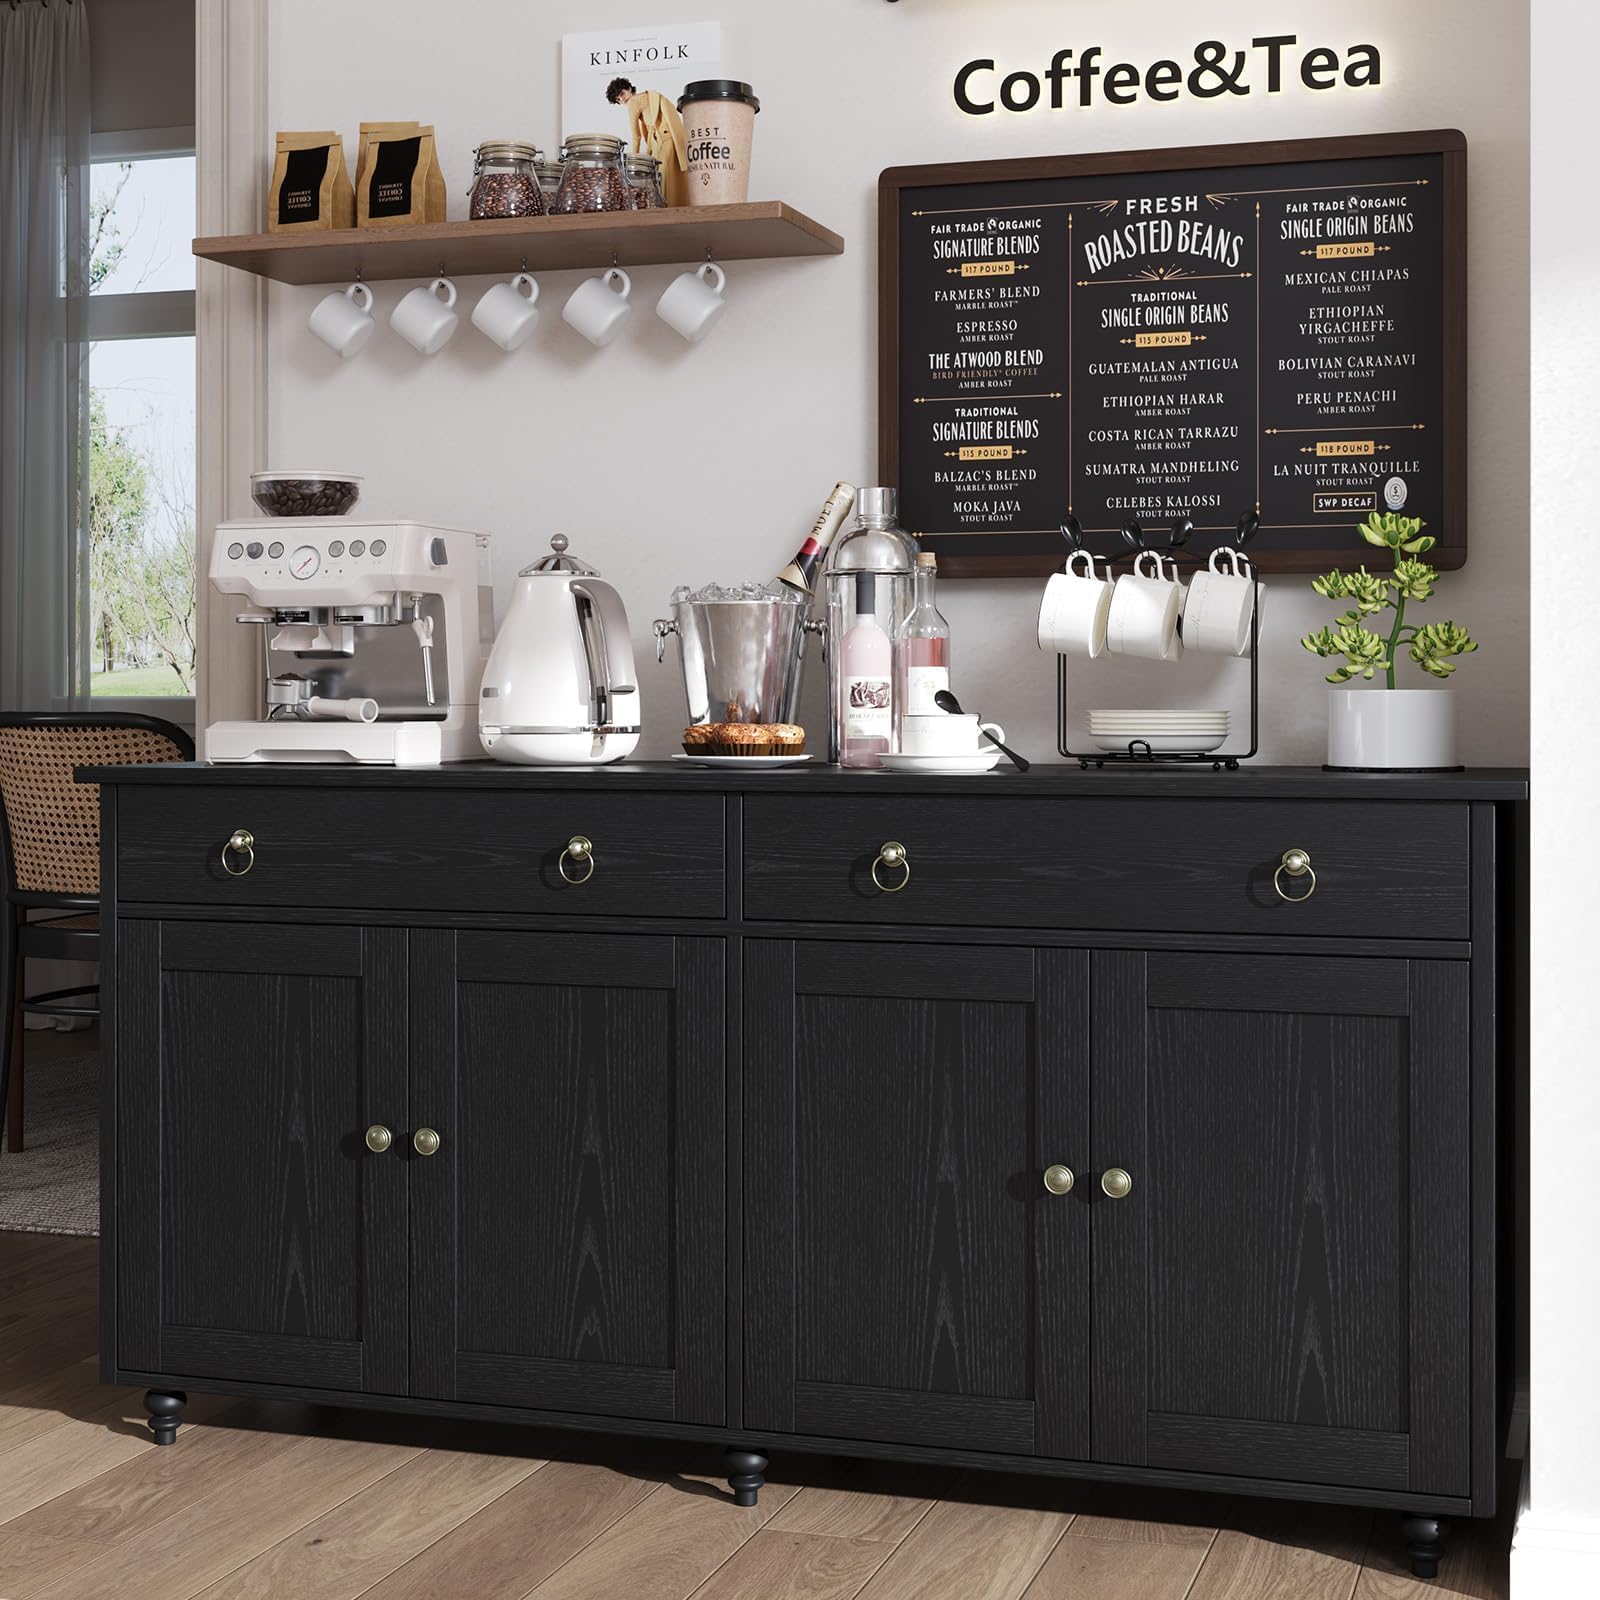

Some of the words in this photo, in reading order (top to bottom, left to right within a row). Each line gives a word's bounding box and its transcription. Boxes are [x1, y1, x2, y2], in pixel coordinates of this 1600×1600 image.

[590, 45, 688, 66] KINFOLK
[954, 34, 1382, 115] Coffee&Tea
[690, 128, 719, 138] BEST
[687, 142, 731, 162] Coffee
[704, 162, 735, 170] NATURAL
[1126, 196, 1198, 215] FRESH
[1286, 203, 1308, 213] FAIR
[1313, 201, 1344, 212] TRADE
[1360, 197, 1407, 209] ORGANIC
[931, 225, 951, 234] FAIR
[956, 223, 984, 232] TRADE
[999, 219, 1041, 230] ORGANIC
[1281, 218, 1322, 240] SINGLE
[1327, 216, 1368, 238] ORIGIN
[1374, 213, 1413, 234] BEANS
[934, 238, 994, 259] SIGNATURE
[997, 235, 1040, 255] BLENDS
[1084, 220, 1172, 274] ROASTED
[1178, 220, 1244, 267] BEANS
[1337, 246, 1369, 255] POUND
[980, 264, 1010, 272] POUND
[1285, 272, 1346, 286] MEXICAN
[1351, 268, 1409, 282] CHIAPAS
[935, 288, 995, 301] FARMERS'
[1000, 286, 1040, 298] BLEND
[1322, 286, 1341, 294] PALE
[1344, 284, 1372, 293] ROAST
[1131, 291, 1197, 303] TRADITIONAL
[955, 302, 986, 310] MARBLE
[1309, 305, 1384, 319] ETHIOPIAN
[1101, 308, 1141, 328] SINGLE
[1145, 305, 1185, 325] ORIGIN
[1190, 303, 1229, 324] BEANS
[957, 320, 1017, 333] ESPRESSO
[1300, 320, 1394, 335] YIRGACHEFFE
[1156, 335, 1187, 343] POUND
[1318, 336, 1345, 344] STOUT
[1349, 335, 1375, 343] ROAST
[929, 353, 950, 369] THE
[954, 351, 1001, 368] ATWOOD
[1006, 350, 1043, 366] BLEND
[1279, 357, 1342, 370] BOLIVIAN
[1348, 354, 1416, 368] CARANAVI
[1006, 368, 1038, 376] COFFEE
[1089, 361, 1175, 375] GUATEMALAN
[1180, 358, 1239, 371] ANTIGUA
[1140, 375, 1159, 383] PALE
[1161, 374, 1187, 382] ROAST
[1318, 371, 1345, 379] STOUT
[1349, 370, 1375, 378] ROAST
[958, 381, 985, 389] AMBER
[1103, 394, 1174, 408] ETHIOPIAN
[1180, 393, 1224, 405] HARAR
[1297, 393, 1331, 405] PERU
[1337, 390, 1396, 403] PENACHI
[955, 407, 1018, 417] TRADITIONAL
[1165, 408, 1191, 416] ROAST
[1317, 406, 1346, 414] AMBER
[1349, 405, 1376, 413] ROAST
[933, 421, 993, 441] SIGNATURE
[997, 419, 1039, 439] BLENDS
[1089, 430, 1129, 442] COSTA
[1134, 428, 1174, 440] RICAN
[1179, 426, 1239, 439] TARRAZU
[1135, 442, 1162, 450] AMBER
[1165, 442, 1191, 450] ROAST
[1337, 445, 1369, 453] POUND
[978, 449, 1008, 457] POUND
[1086, 463, 1145, 476] SUMATRA
[1151, 460, 1239, 474] MANDHELING
[1274, 465, 1289, 476] LA
[1295, 463, 1327, 475] NUIT
[1332, 461, 1420, 477] TRANQUILLE
[935, 470, 992, 482] BALZAC'S
[997, 469, 1036, 480] BLEND
[1136, 476, 1162, 484] STOUT
[1316, 478, 1342, 486] STOUT
[1346, 477, 1373, 485] ROAST
[955, 484, 986, 492] MARBLE
[953, 502, 988, 513] MOKA
[992, 500, 1021, 514] JAVA
[1106, 496, 1161, 508] CELEBES
[1167, 495, 1221, 507] KALOSSI
[1318, 498, 1337, 507] SWP
[1342, 497, 1372, 507] DECAF
[1136, 510, 1162, 518] STOUT
[1165, 509, 1191, 517] ROAST
